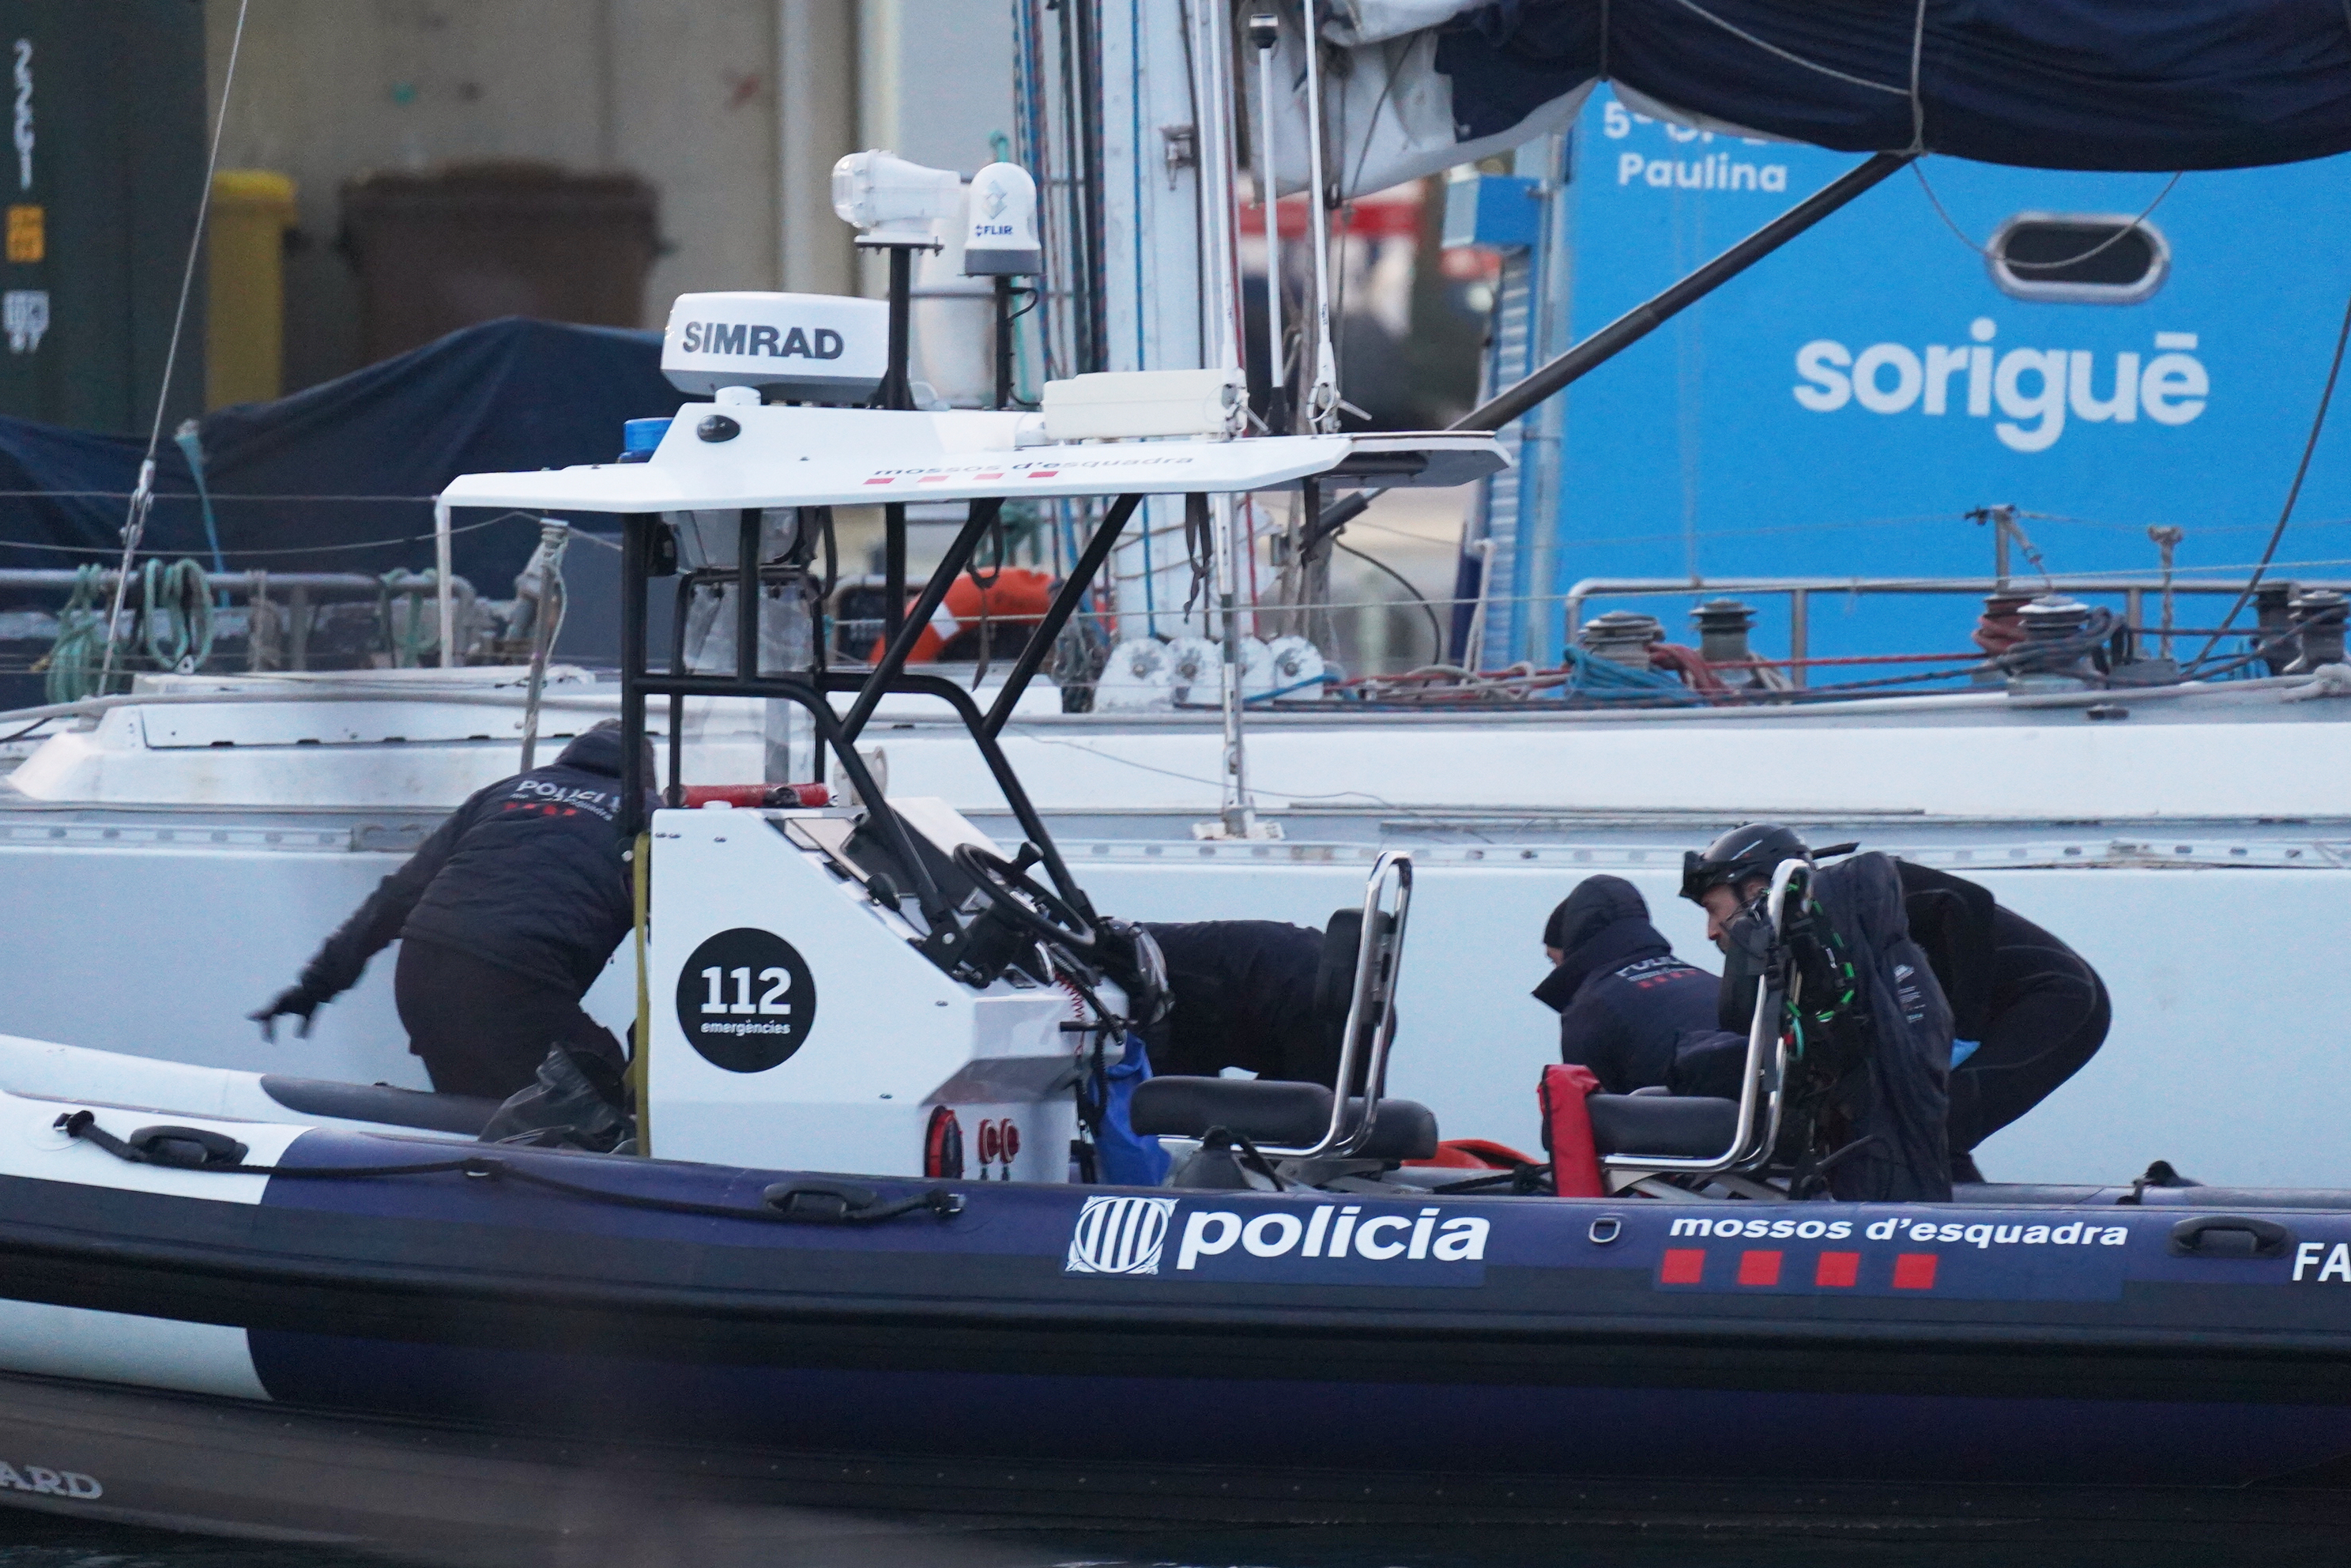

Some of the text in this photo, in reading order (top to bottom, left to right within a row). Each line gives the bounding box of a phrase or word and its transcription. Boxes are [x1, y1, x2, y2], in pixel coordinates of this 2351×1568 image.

[1618, 152, 1788, 192] Paulina
[984, 225, 1013, 235] FLIR
[683, 321, 845, 360] SIMRAD
[873, 465, 1002, 476] mossos
[701, 966, 791, 1015] 112
[1176, 1204, 1490, 1270] policia
[1669, 1218, 2129, 1249] mossos d'esquadra
[2293, 1242, 2351, 1282] FA
